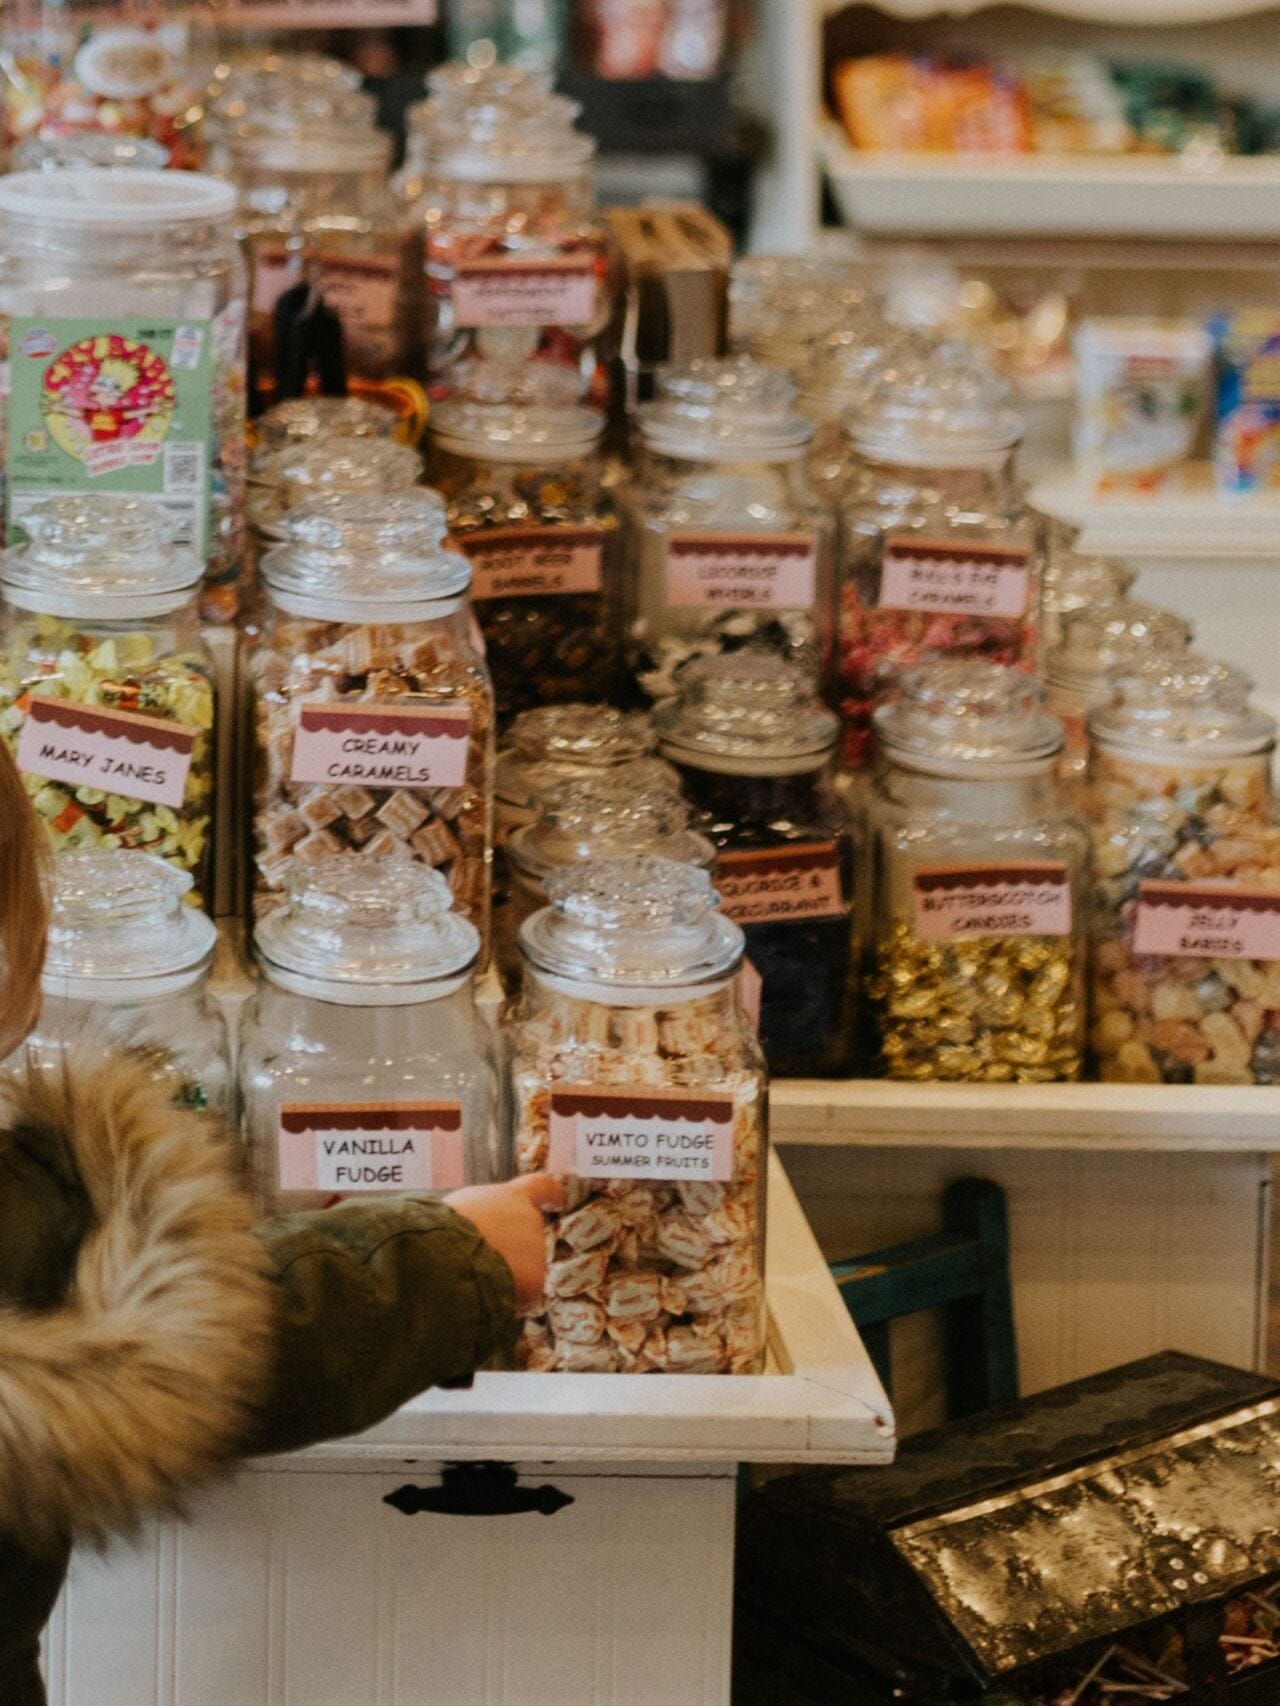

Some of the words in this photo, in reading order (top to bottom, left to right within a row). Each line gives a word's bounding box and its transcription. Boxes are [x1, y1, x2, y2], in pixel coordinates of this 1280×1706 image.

[341, 738, 421, 756] CREAMY
[38, 744, 95, 768] MARY
[99, 757, 168, 785] JANES
[327, 763, 431, 782] CARAMELS
[952, 914, 1033, 932] CANDIES
[1187, 914, 1239, 931] JELLY
[1179, 936, 1244, 954] BABIES
[323, 1138, 415, 1155] VANILLA
[586, 1132, 649, 1149] VIMTO
[656, 1134, 715, 1150] FUDGE
[590, 1155, 651, 1167] SUMMER
[656, 1156, 710, 1169] FRUITS
[335, 1165, 404, 1183] FUDGE
